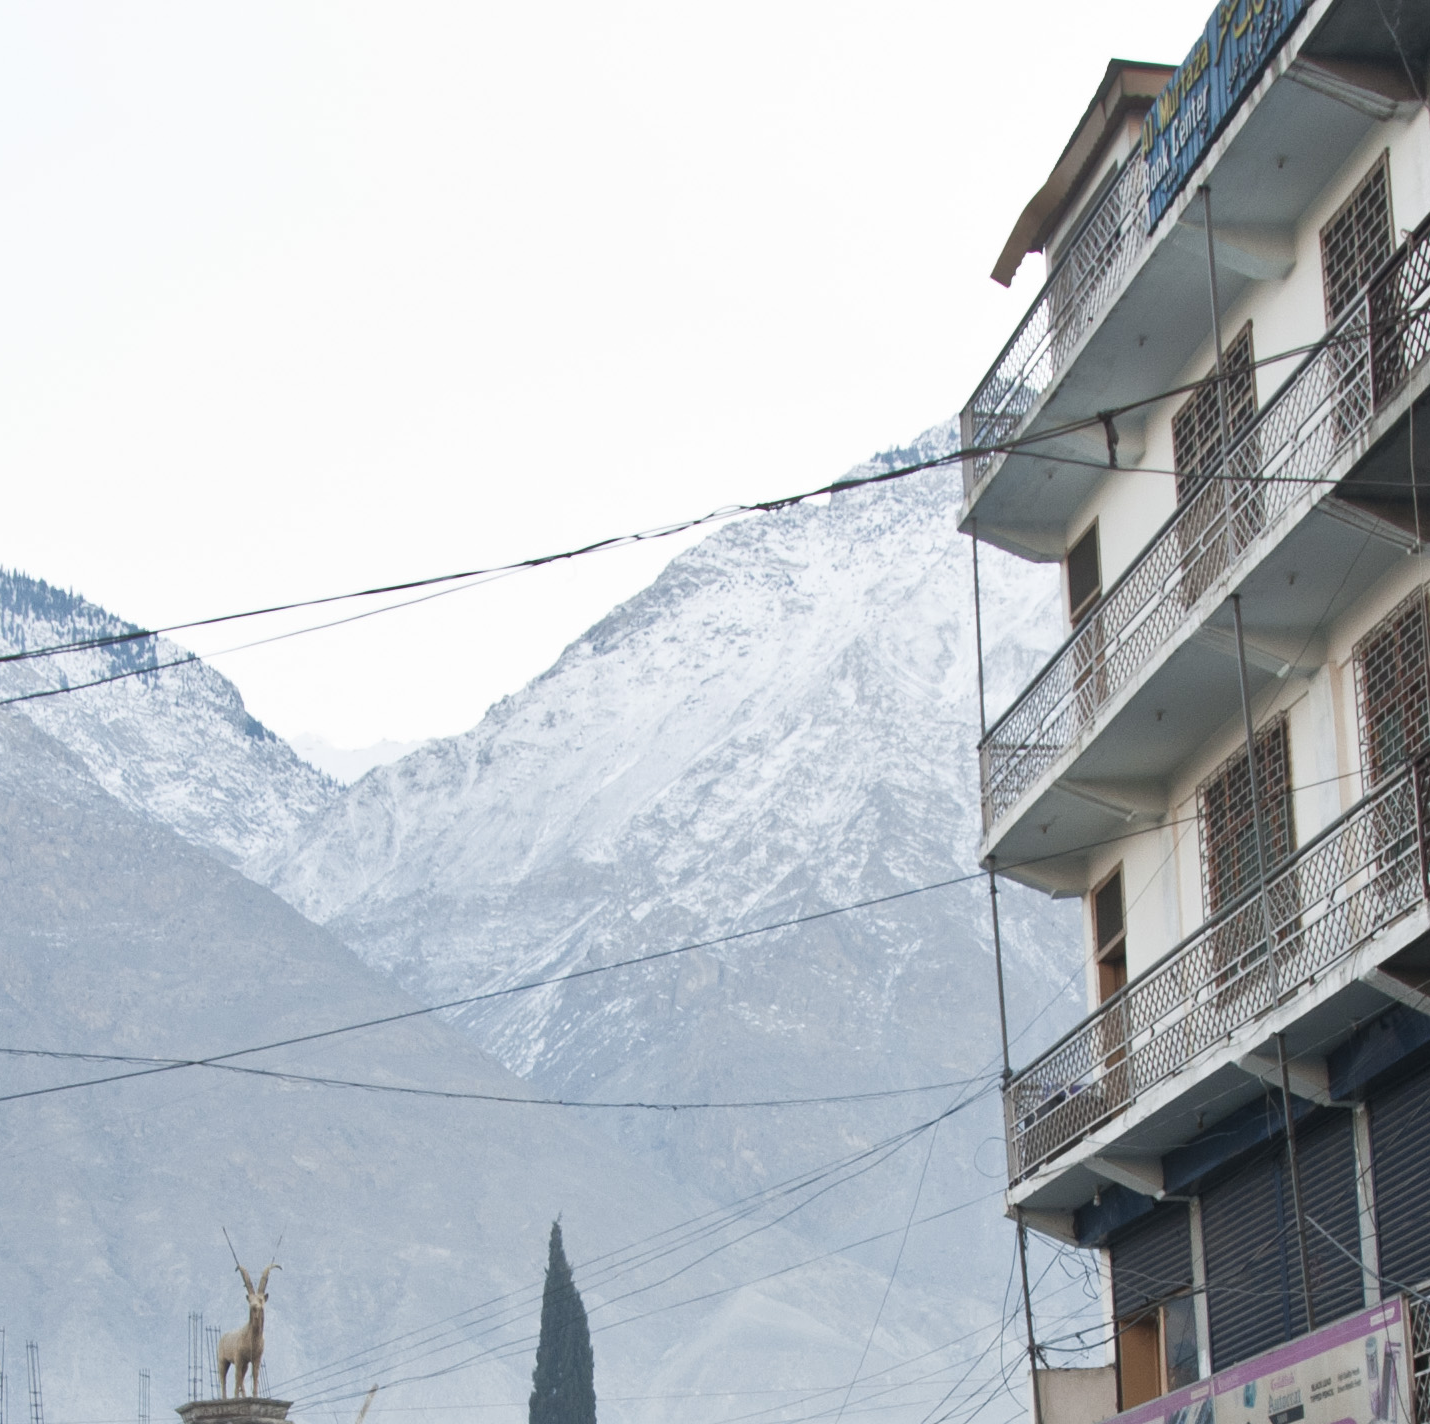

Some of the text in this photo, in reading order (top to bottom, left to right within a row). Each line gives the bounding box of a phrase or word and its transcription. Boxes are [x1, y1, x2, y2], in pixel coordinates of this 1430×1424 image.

[1157, 40, 1210, 135] Murtaza
[1142, 84, 1210, 197] Book Center
